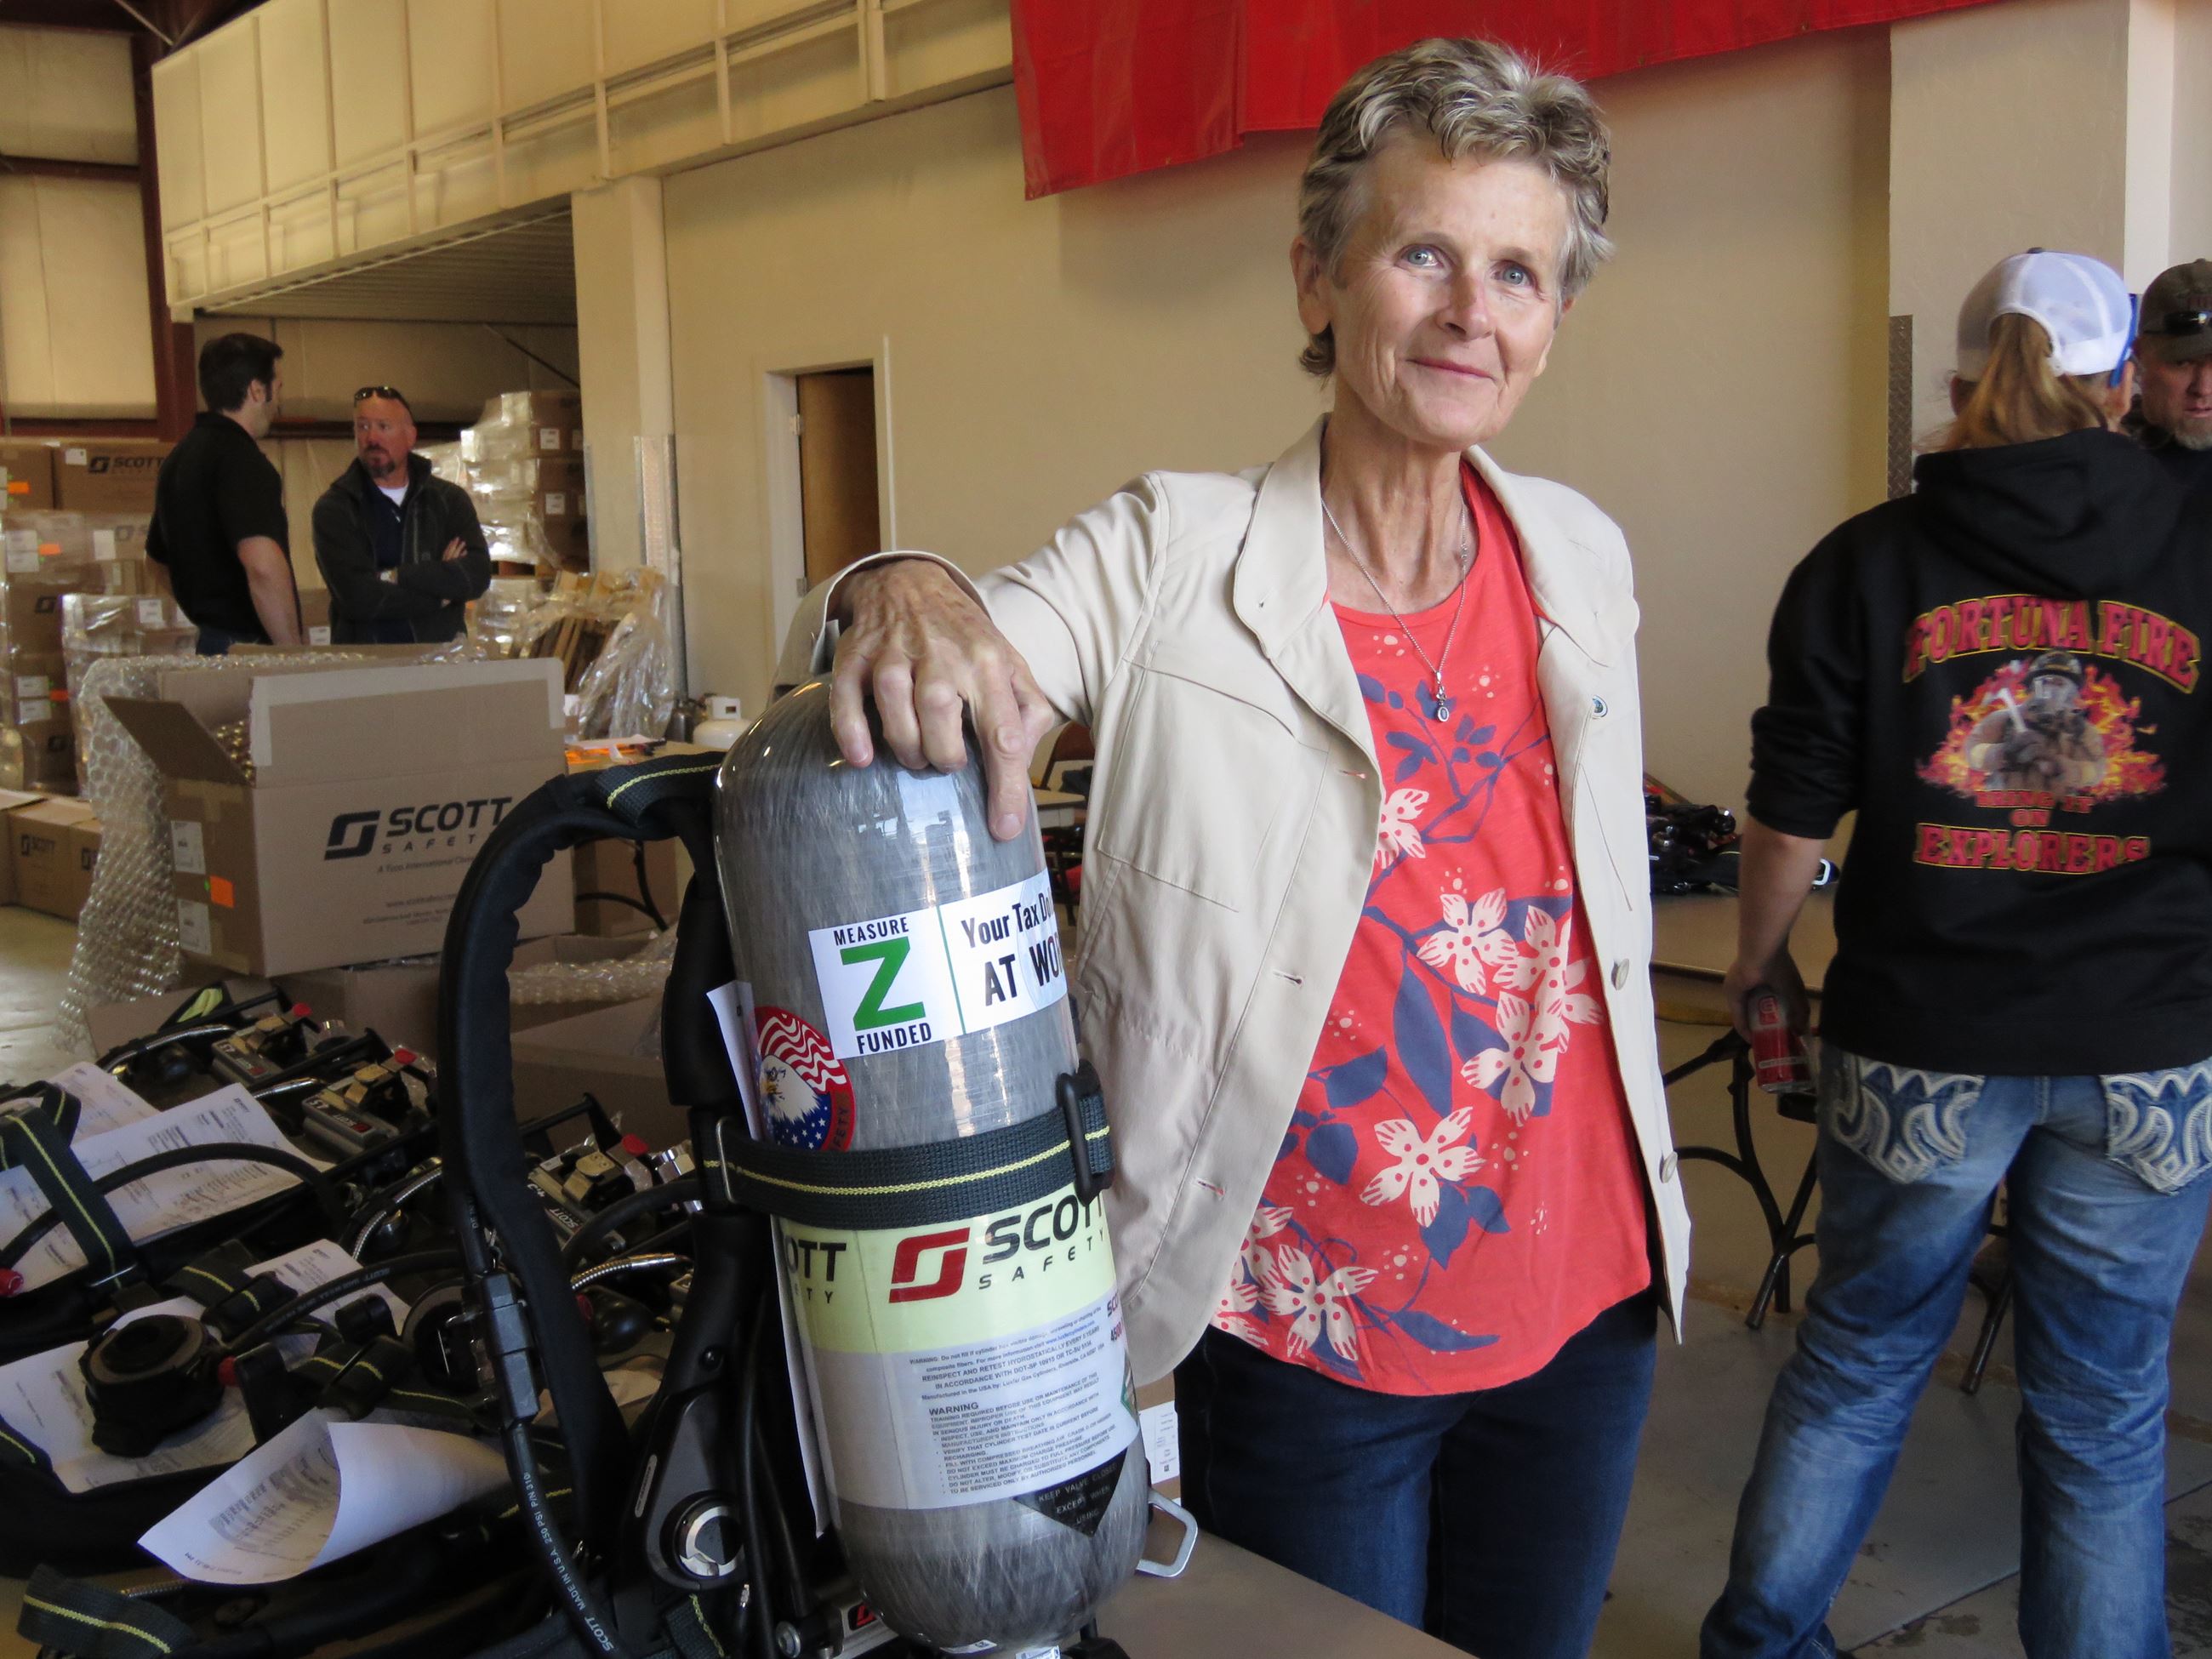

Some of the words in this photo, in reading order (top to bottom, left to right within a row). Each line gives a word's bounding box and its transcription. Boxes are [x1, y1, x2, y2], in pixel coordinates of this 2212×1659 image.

[1903, 593, 2095, 683] FORTUNA
[2098, 600, 2202, 694] FIRE
[385, 796, 513, 838] SCOTT
[381, 834, 477, 854] SAFET
[1913, 823, 2150, 875] EXPLORERS
[833, 916, 909, 946] MEASURE
[961, 915, 1010, 949] Your
[1012, 903, 1040, 932] Tax
[840, 936, 926, 1032] Z
[984, 954, 1018, 1006] AT
[857, 1023, 932, 1054] FUNDED
[549, 1208, 579, 1229] SCOTT
[784, 1234, 847, 1282] OTT
[978, 1228, 1103, 1290] SAFETY
[922, 1370, 961, 1382] REINSPECT
[963, 1366, 978, 1376] AND
[979, 1360, 1006, 1372] RETEST
[1007, 1342, 1065, 1366] HYDROSTATICALLY
[1065, 1335, 1082, 1348] EVERY
[975, 1345, 998, 1356] cylinder
[977, 1357, 986, 1365] For
[987, 1353, 1002, 1363] more
[1003, 1344, 1035, 1359] information
[944, 1373, 994, 1388] ACCORDANCE
[995, 1369, 1012, 1379] WITH
[978, 1383, 992, 1393] USA
[928, 1402, 979, 1417] WARNING
[931, 1413, 960, 1423] TRAINING
[961, 1406, 994, 1419] REQUIRED
[995, 1400, 1021, 1412] BEFORE
[1022, 1396, 1034, 1405] USE
[1045, 1379, 1080, 1399] MAINTENANCE
[940, 1425, 968, 1435] SERIOUS
[970, 1421, 992, 1431] INJURY
[986, 1426, 1000, 1435] AND
[1001, 1418, 1029, 1432] MAINTAIN
[1030, 1413, 1046, 1423] ONLY
[1053, 1396, 1088, 1416] ACCORDANCE
[943, 1445, 966, 1455] VERIFY
[966, 1443, 983, 1451] THAT
[984, 1436, 1016, 1449] CYLINDER
[1018, 1431, 1032, 1441] TEST
[1033, 1426, 1048, 1437] DATE
[1056, 1413, 1080, 1428] CURRENT
[948, 1471, 979, 1482] CYLINDER
[980, 1468, 999, 1477] MUST
[1009, 1457, 1040, 1471] CHARGED
[1050, 1448, 1063, 1459] FULL
[960, 1457, 977, 1466] WITH
[977, 1448, 1021, 1463] COMPRESSED
[1022, 1438, 1055, 1454] BREATHING
[972, 1461, 998, 1472] EXCEED
[999, 1453, 1029, 1467] MAXIMUM
[1029, 1445, 1054, 1459] CHARGE
[960, 1479, 973, 1487] NOT
[970, 1480, 1002, 1491] SERVICED
[1002, 1477, 1019, 1486] ONLY
[1030, 1462, 1066, 1479] AUTHORIZED
[1038, 1489, 1062, 1502] KEEP
[1064, 1479, 1088, 1494] VALVE
[527, 1491, 539, 1509] P/N
[1056, 1495, 1086, 1514] EXCEPT
[533, 1510, 545, 1529] PSI
[539, 1527, 553, 1546] 250
[562, 1573, 573, 1585] IN
[567, 1584, 587, 1611] MADE
[584, 1616, 613, 1653] SCOTT
